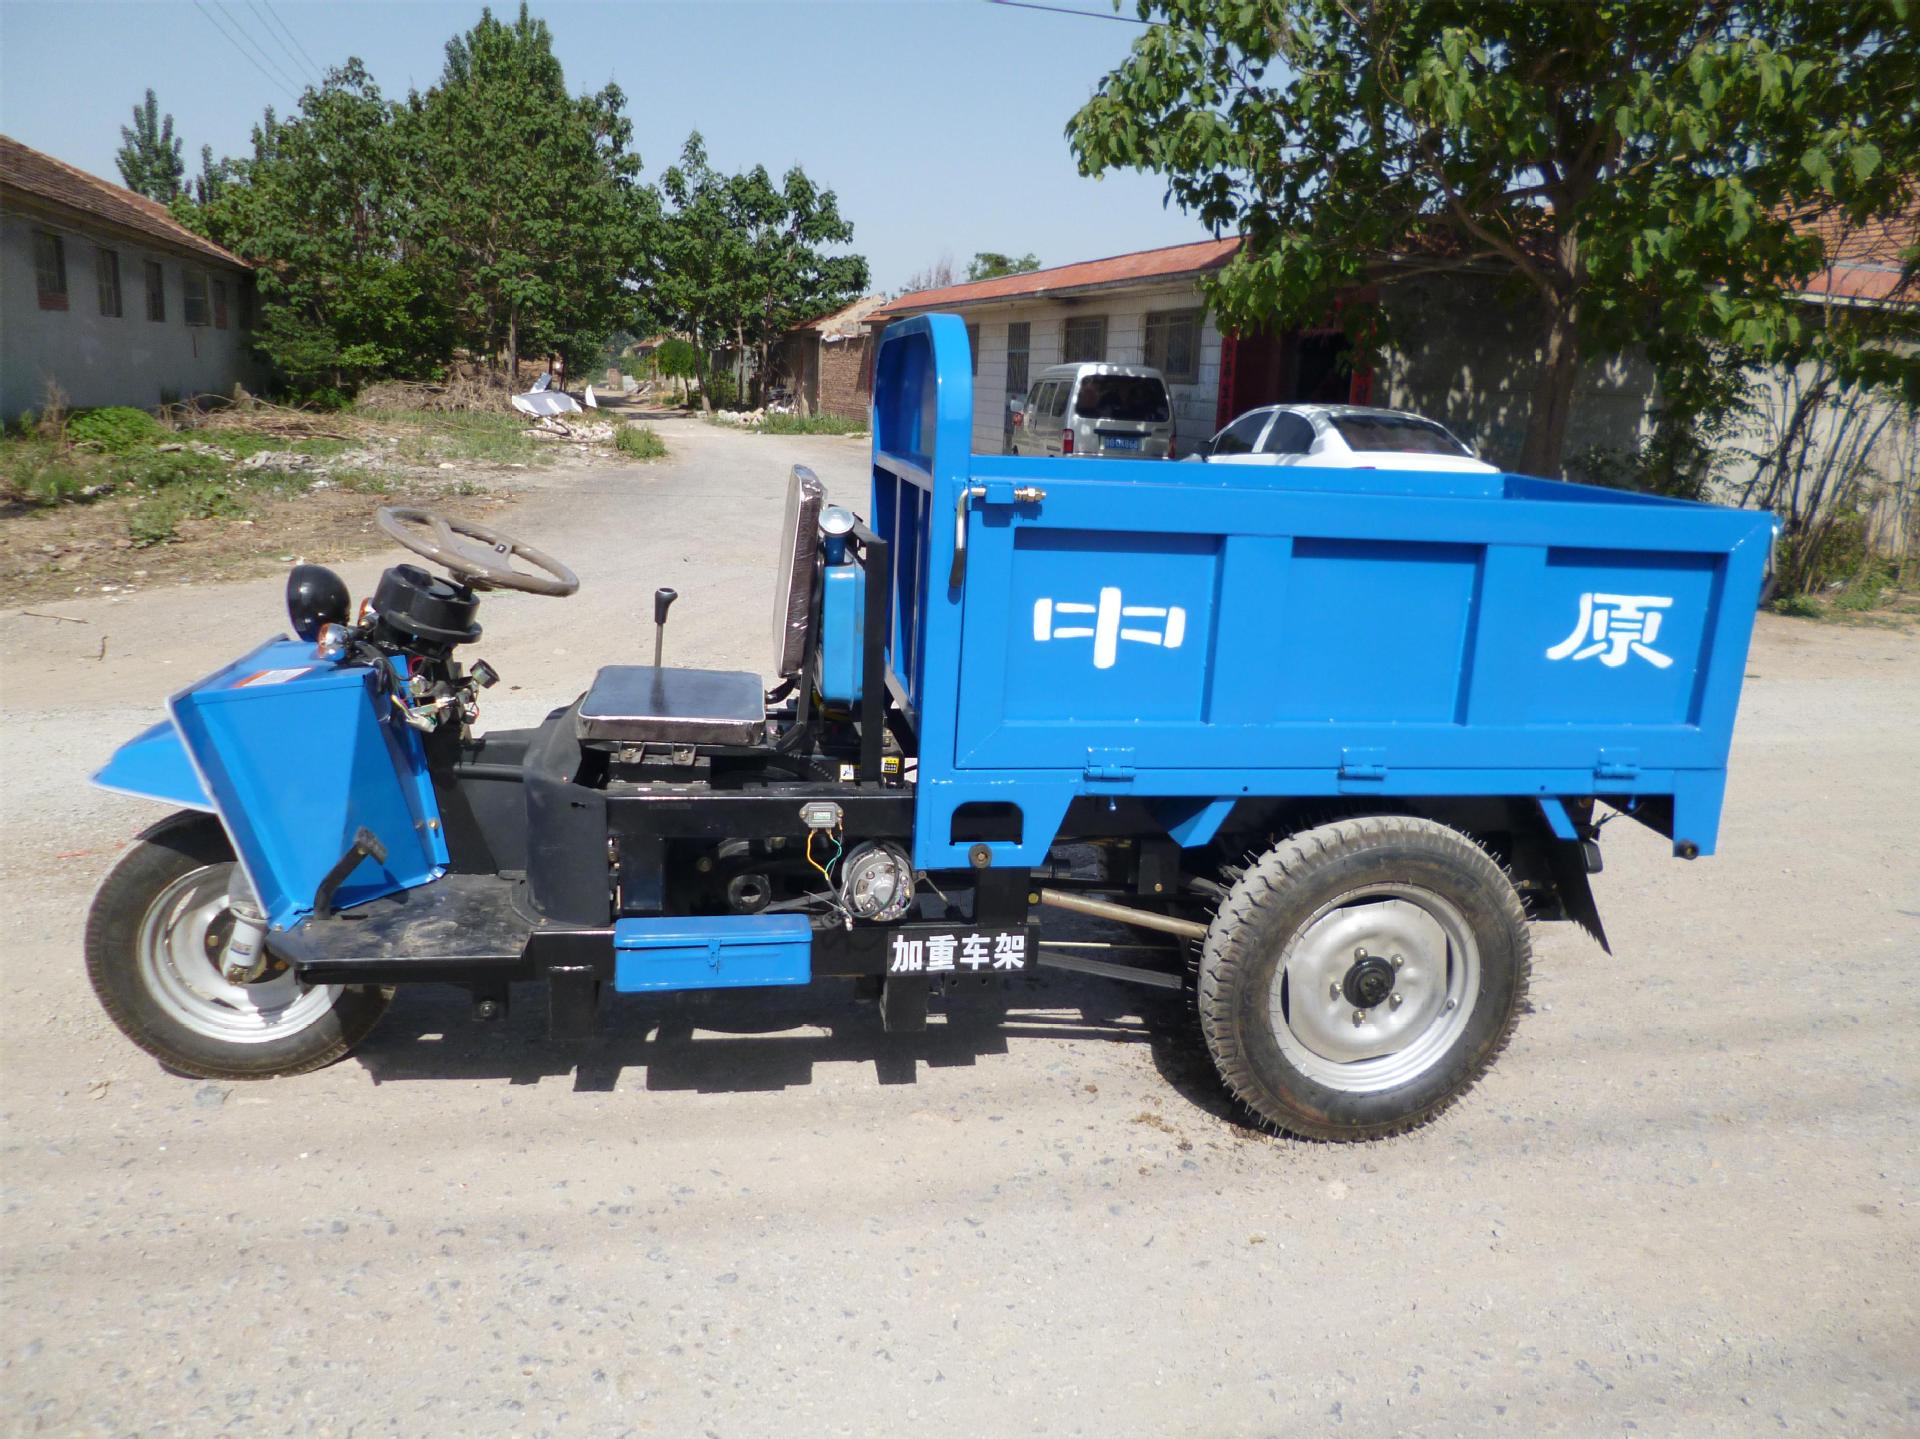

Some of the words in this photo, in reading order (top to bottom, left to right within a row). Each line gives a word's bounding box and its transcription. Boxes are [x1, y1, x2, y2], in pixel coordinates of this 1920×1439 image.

[1033, 587, 1186, 669] 中
[1546, 592, 1674, 669] 原
[890, 932, 1025, 973] 加重车架
